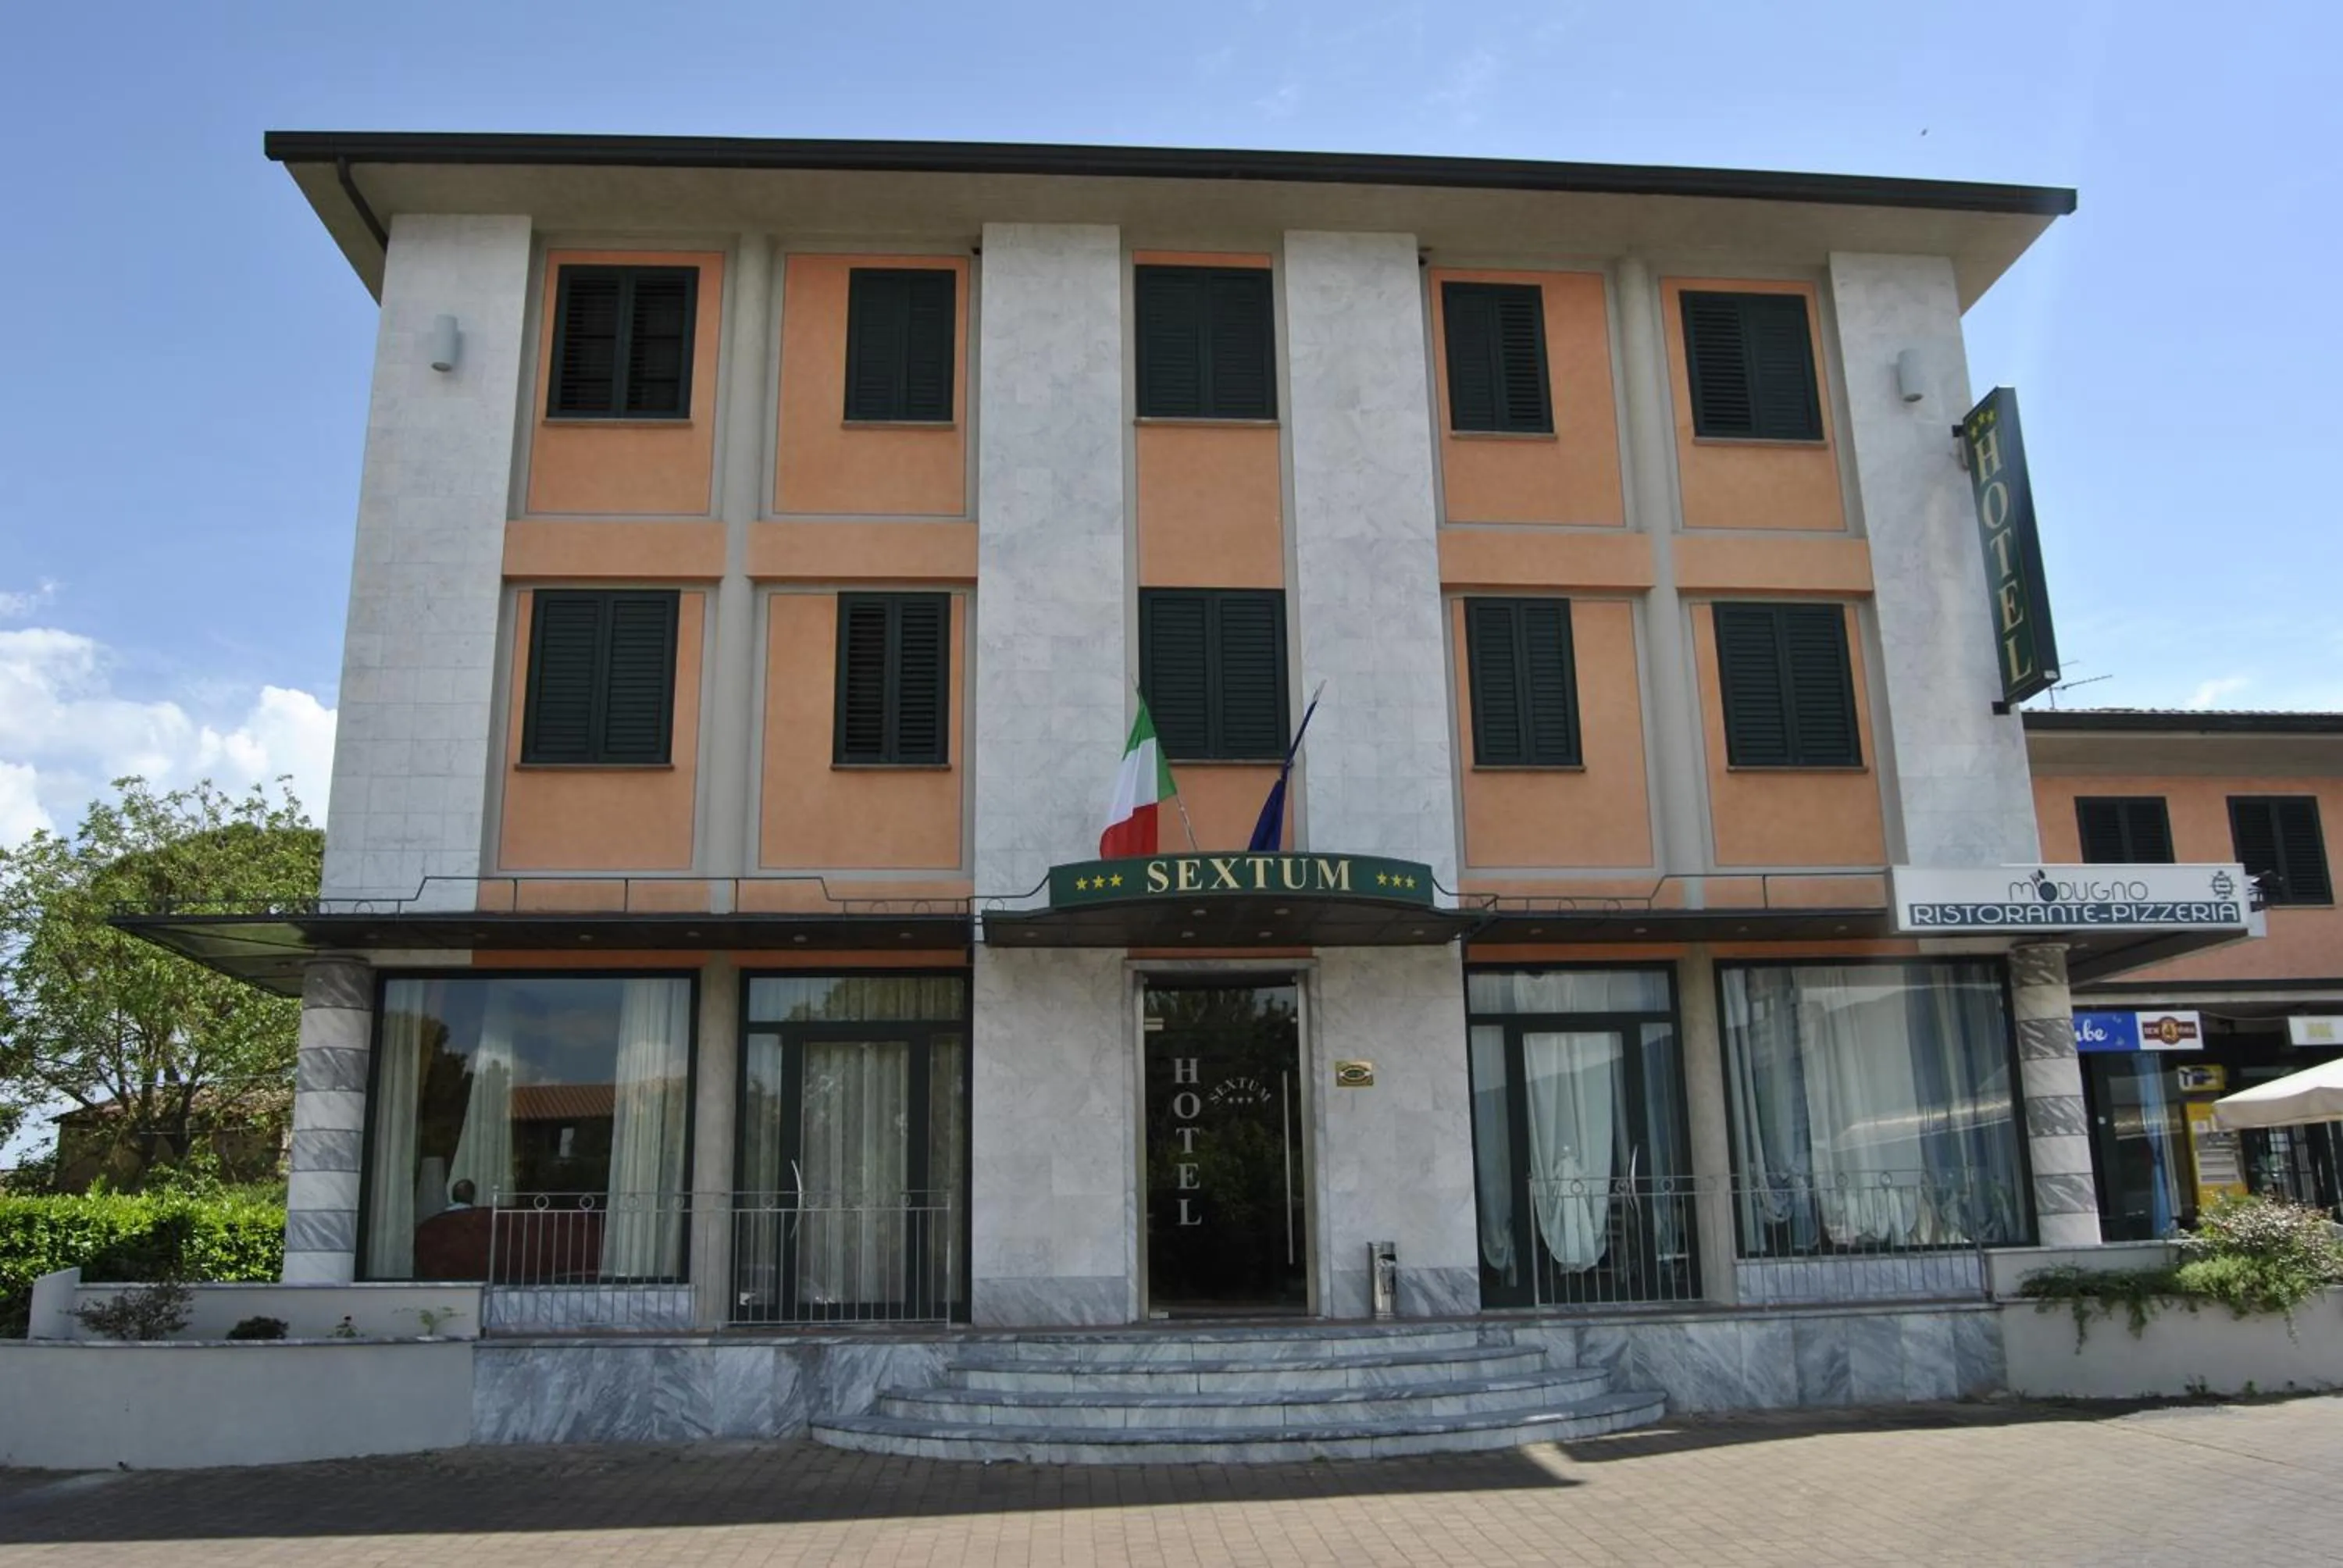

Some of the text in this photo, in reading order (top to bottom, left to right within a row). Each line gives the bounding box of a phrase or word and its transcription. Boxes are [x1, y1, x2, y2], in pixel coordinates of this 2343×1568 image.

[1974, 426, 2031, 683] HOTEL
[1147, 857, 1352, 893] SEXTUM
[1174, 1057, 1203, 1225] HOTEL
[1208, 1077, 1271, 1106] SEXTUM
